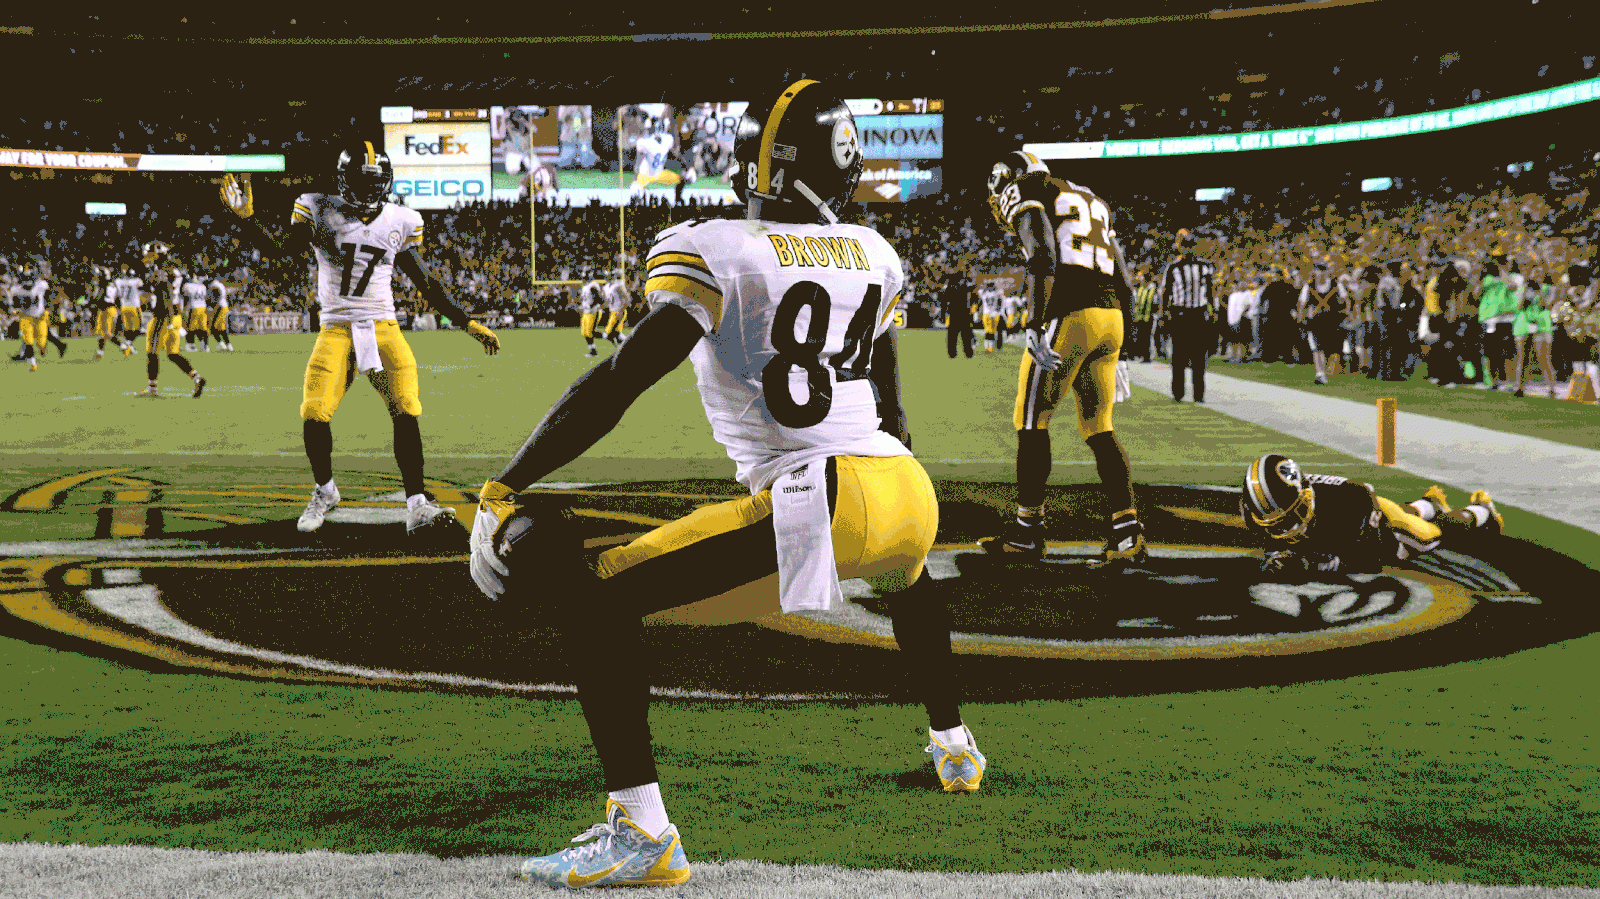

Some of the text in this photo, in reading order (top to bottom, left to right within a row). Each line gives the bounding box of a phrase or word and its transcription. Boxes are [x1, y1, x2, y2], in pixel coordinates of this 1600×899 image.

[404, 134, 469, 155] FedEx
[863, 127, 939, 147] INOVA
[22, 151, 44, 166] FOR
[45, 153, 77, 167] YOUR
[78, 154, 127, 168] COUPON.
[887, 167, 932, 181] America
[392, 180, 485, 196] GEICO
[1054, 191, 1115, 276] 23
[767, 233, 871, 271] BROWN
[340, 242, 387, 297] 17
[253, 315, 300, 331] KICKOFF
[762, 280, 882, 429] 84
